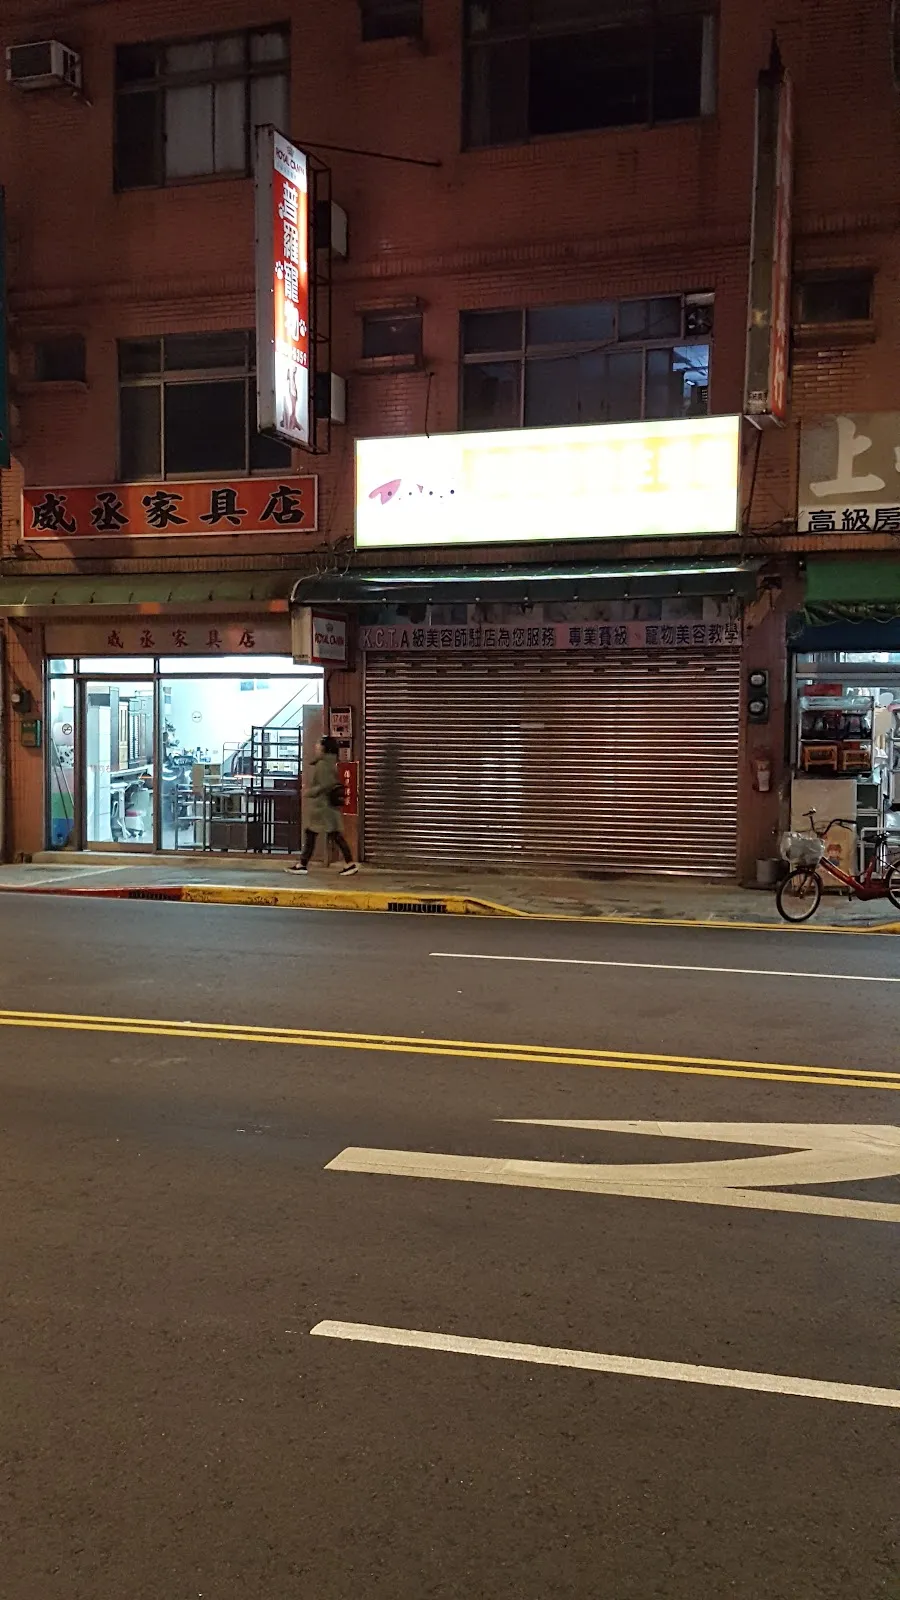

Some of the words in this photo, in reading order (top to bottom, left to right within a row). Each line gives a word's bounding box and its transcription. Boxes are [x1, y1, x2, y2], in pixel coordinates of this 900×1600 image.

[809, 414, 900, 498] 上
[30, 484, 306, 534] 威丞家具店
[107, 628, 256, 650] 威丞家具店
